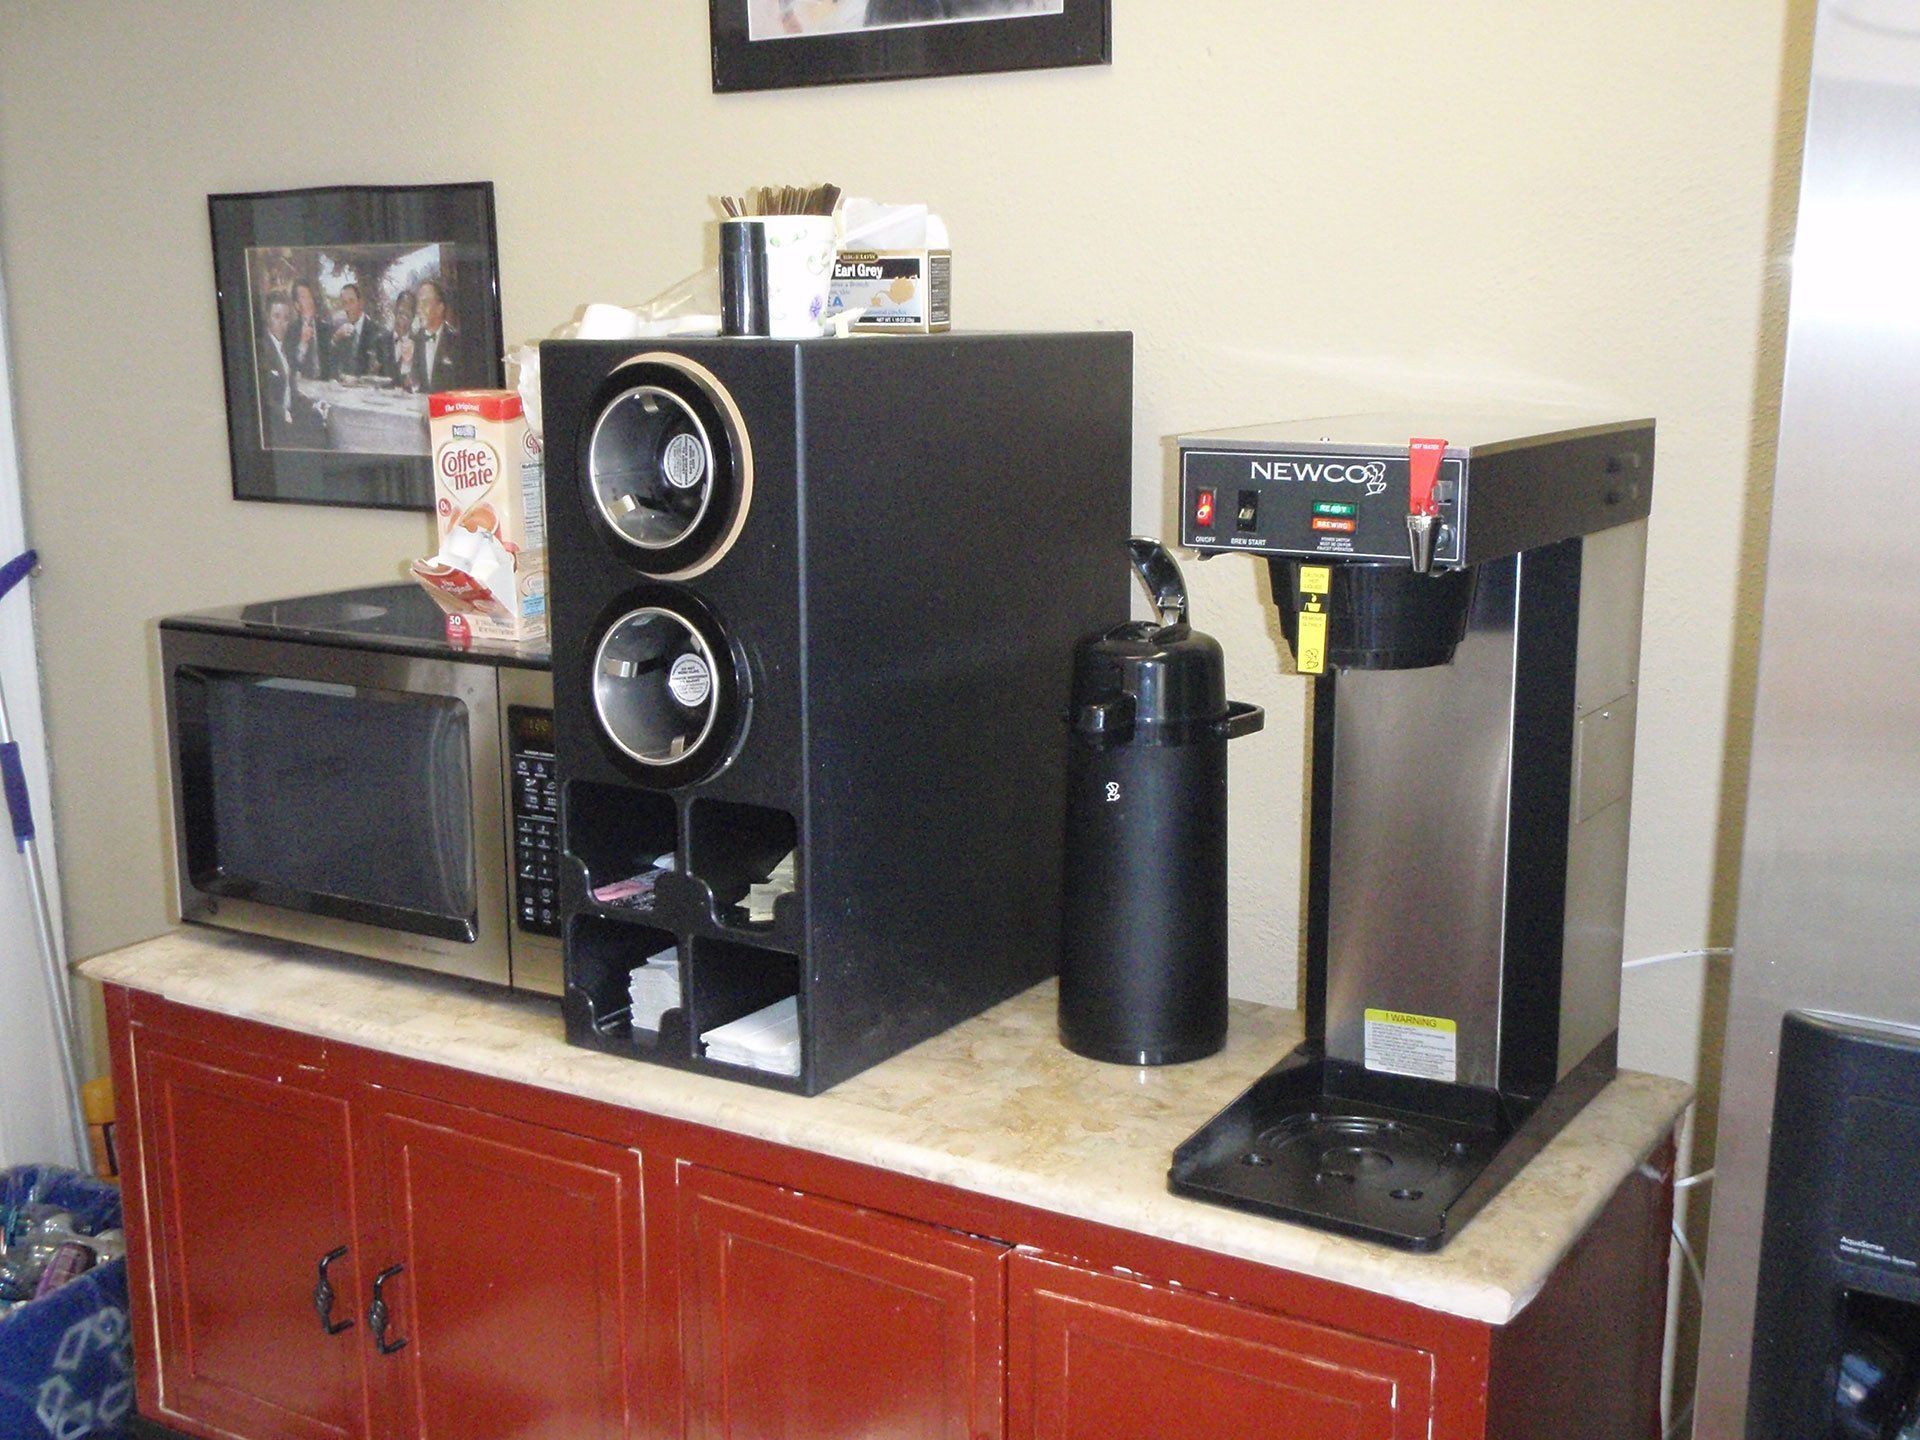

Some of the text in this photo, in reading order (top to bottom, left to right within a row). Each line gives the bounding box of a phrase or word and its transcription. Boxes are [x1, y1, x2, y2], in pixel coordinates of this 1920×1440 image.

[835, 263, 884, 280] Earl Grey
[456, 402, 480, 413] Original
[1250, 461, 1368, 484] NEWCO
[455, 467, 493, 490] mate
[1319, 504, 1348, 514] READY
[1316, 520, 1349, 530] BREWING
[1195, 535, 1216, 543] ON/OFF
[1230, 537, 1267, 546] BREW START
[449, 615, 461, 625] 50
[1391, 1013, 1437, 1028] WARNING
